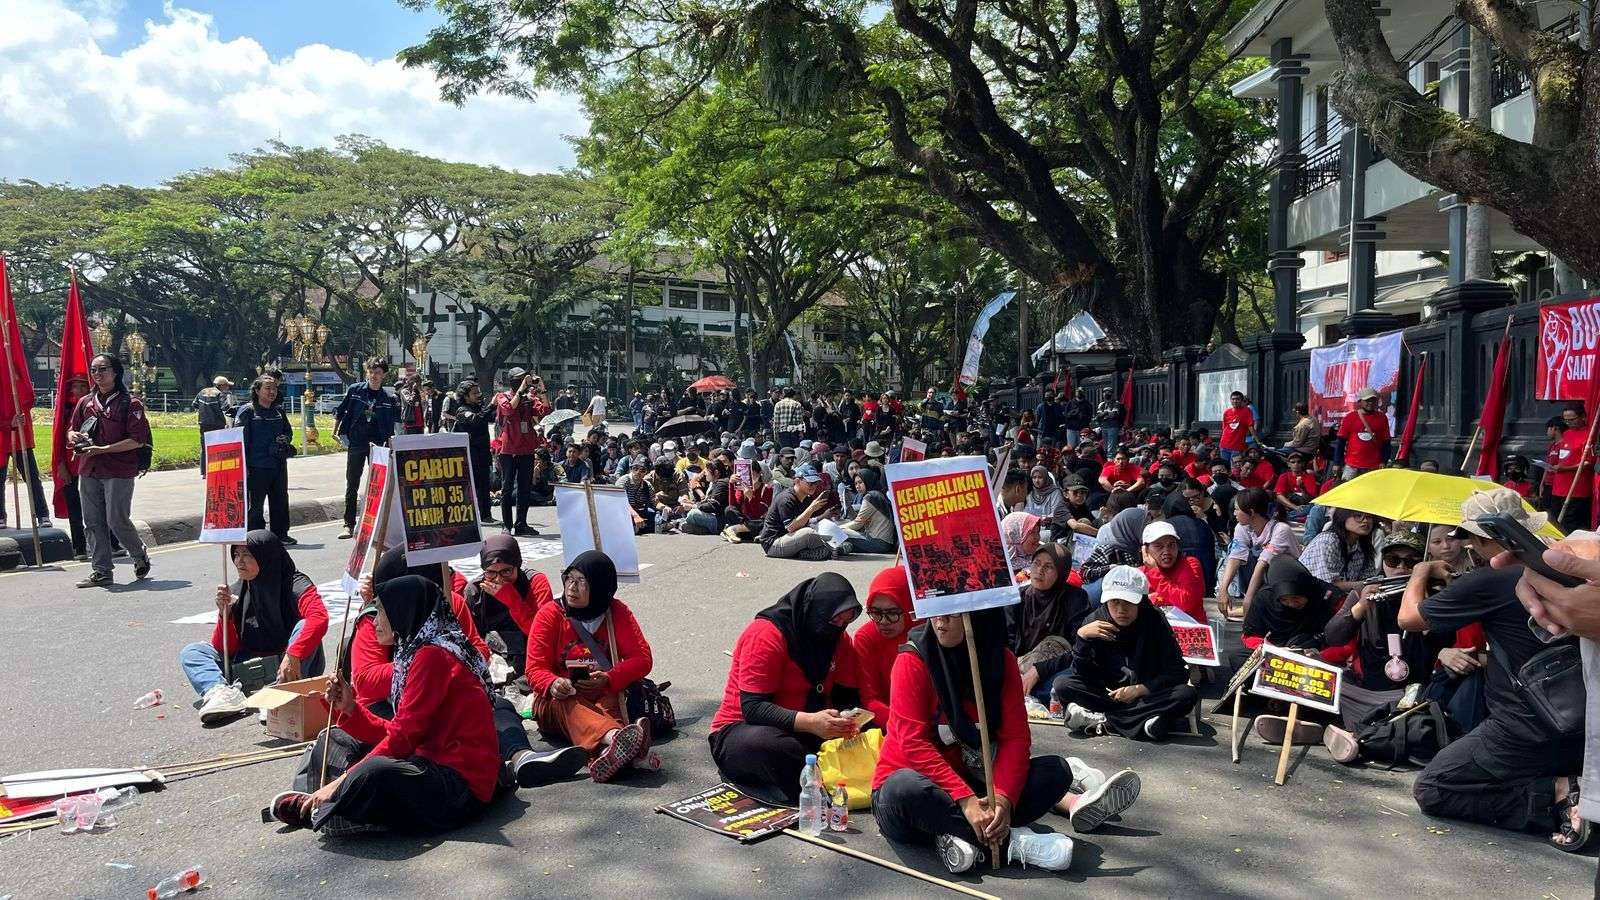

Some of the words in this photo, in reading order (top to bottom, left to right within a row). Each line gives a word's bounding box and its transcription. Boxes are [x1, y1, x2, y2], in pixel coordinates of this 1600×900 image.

[1566, 354, 1596, 381] SAAT
[404, 457, 465, 482] CABUT
[412, 488, 428, 507] PP
[430, 486, 446, 505] NO
[448, 485, 464, 503] 35
[896, 473, 985, 506] KEMBALIKAN
[407, 507, 445, 527] TAHUN
[448, 504, 474, 524] 2021
[899, 491, 980, 523] SUPREMASI
[902, 519, 939, 541] SIPIL
[1270, 658, 1333, 681] CABUT
[1291, 675, 1306, 684] NO
[1265, 674, 1300, 689] TAHUN
[1302, 684, 1332, 698] 2023
